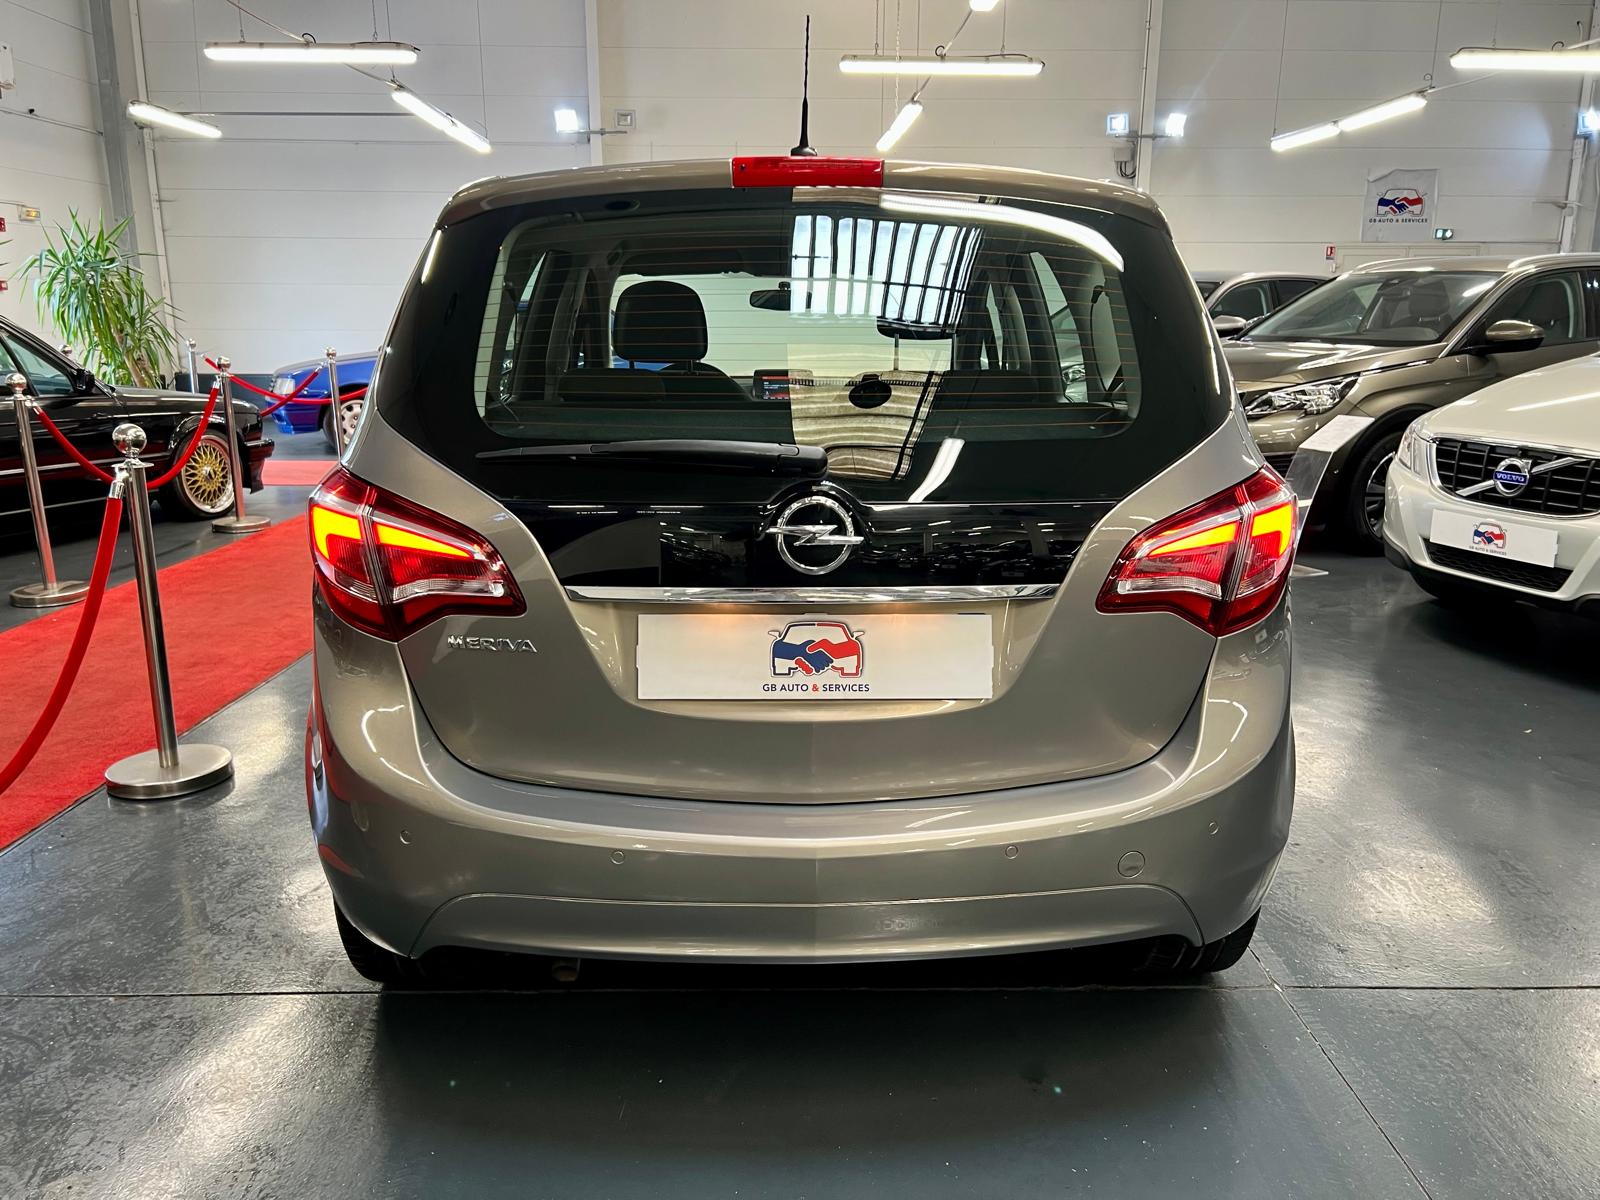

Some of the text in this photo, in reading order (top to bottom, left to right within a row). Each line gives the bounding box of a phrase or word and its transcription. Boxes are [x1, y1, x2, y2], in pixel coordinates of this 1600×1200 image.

[1496, 472, 1525, 482] VOLVO
[447, 635, 538, 653] MERIVA
[762, 683, 870, 692] GB AUTO & SERVICES
